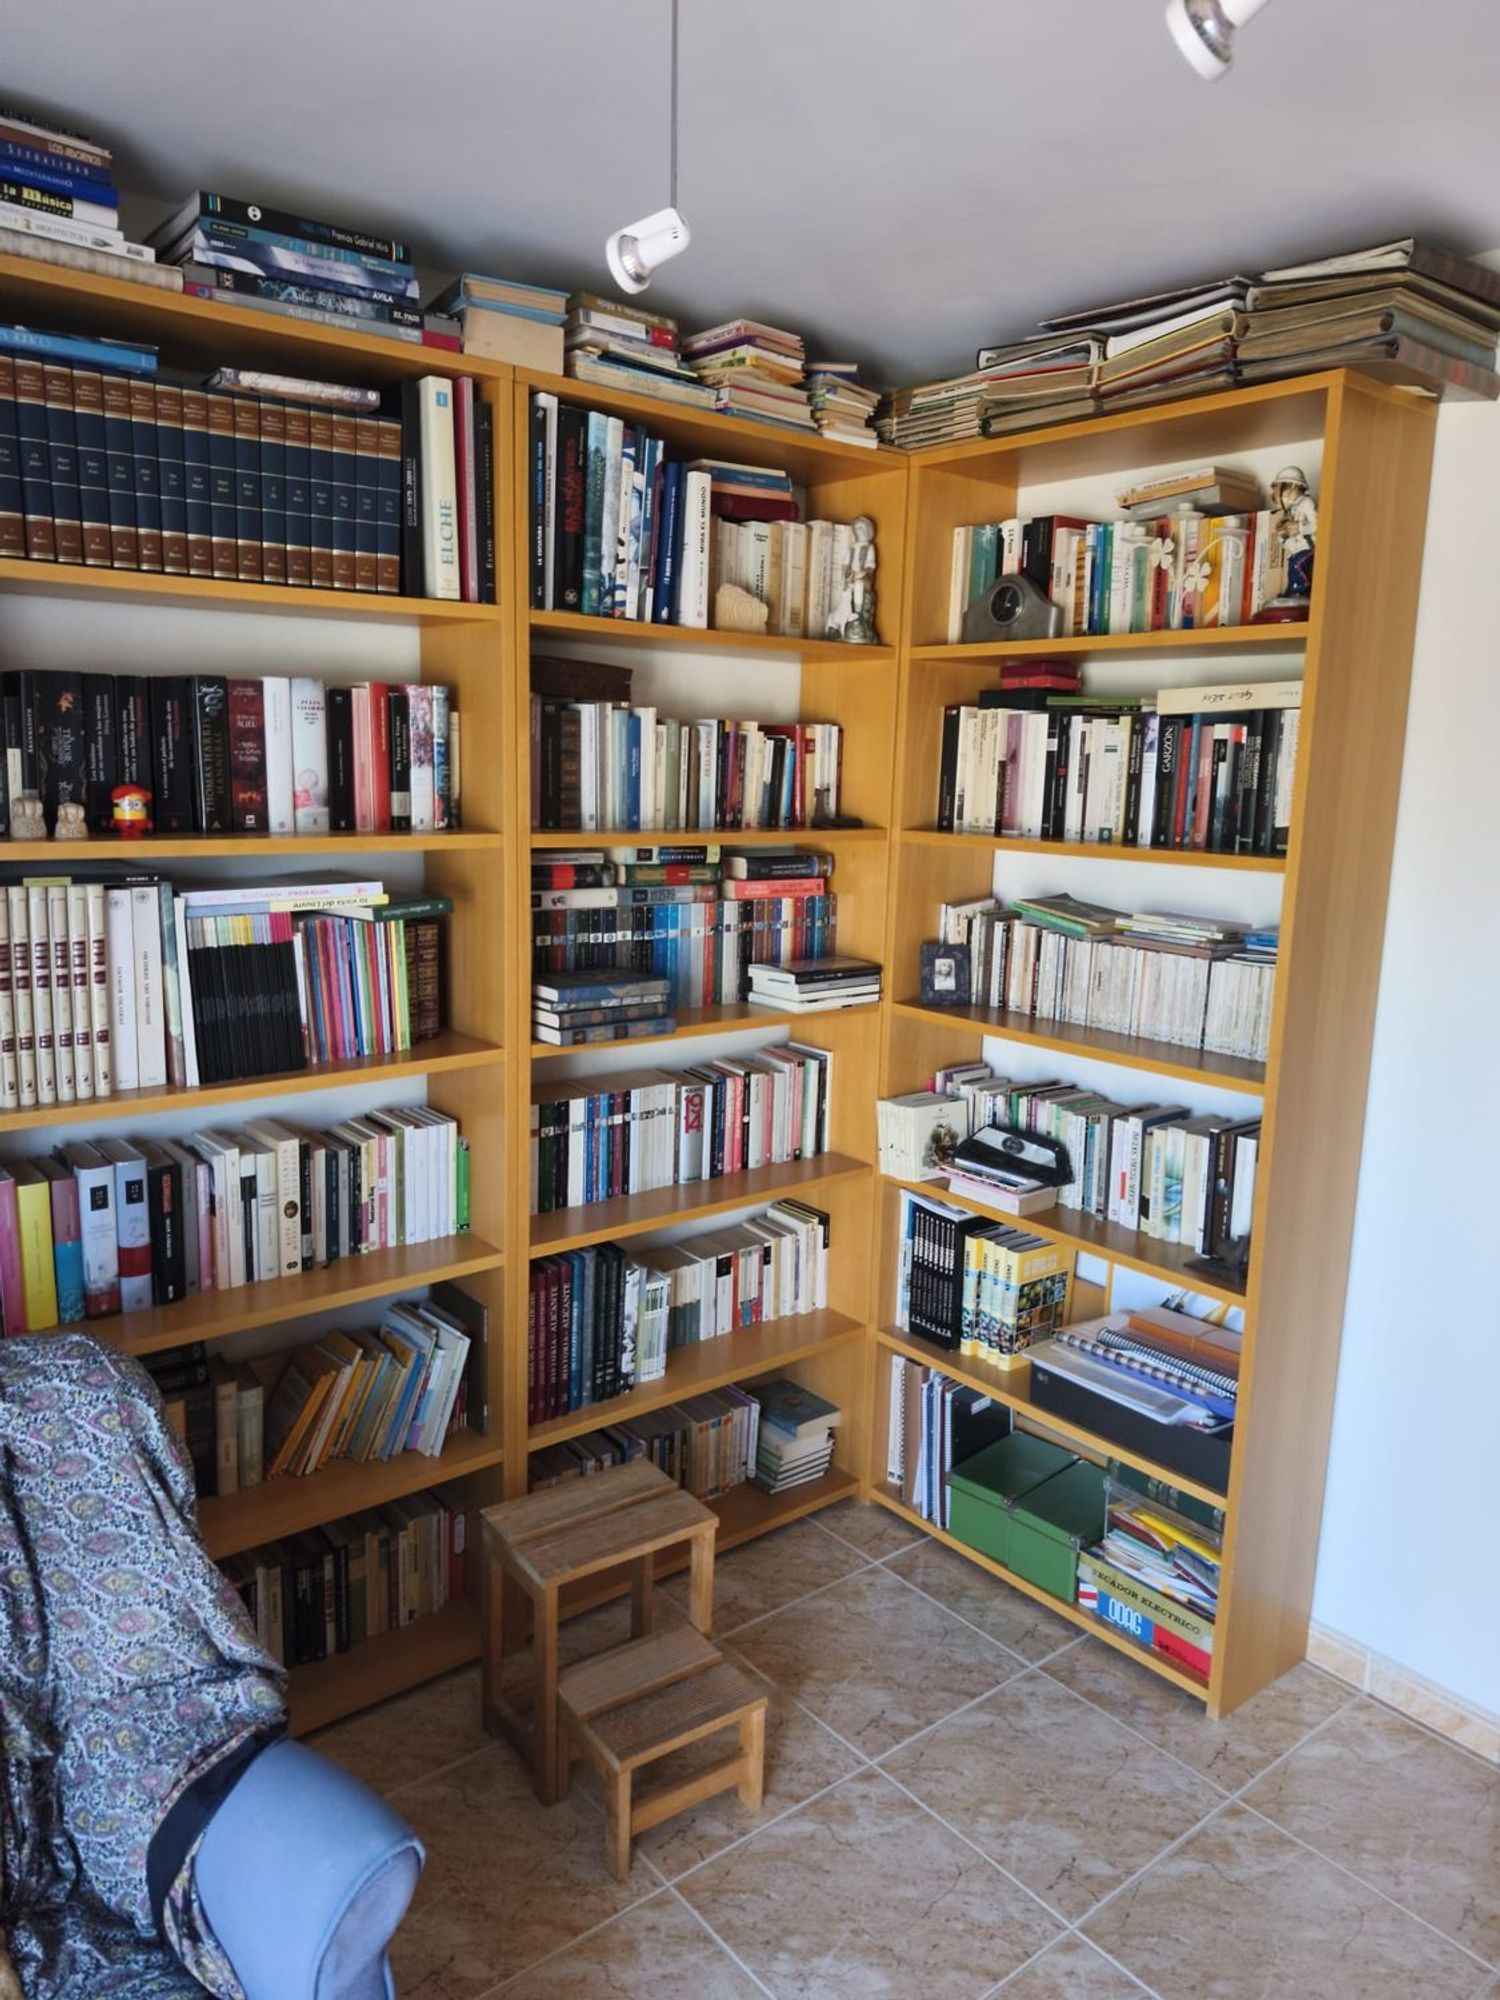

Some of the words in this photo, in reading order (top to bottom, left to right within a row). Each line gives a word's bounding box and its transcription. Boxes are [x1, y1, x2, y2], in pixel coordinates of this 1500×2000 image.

[439, 499, 455, 567] ELCHE
[1161, 726, 1174, 773] GARZÓN
[204, 764, 215, 812] THOMAS
[550, 1286, 558, 1332] ALICANTE
[562, 1282, 570, 1328] ALICANTE
[1141, 1595, 1200, 1635] ELECTRICO
